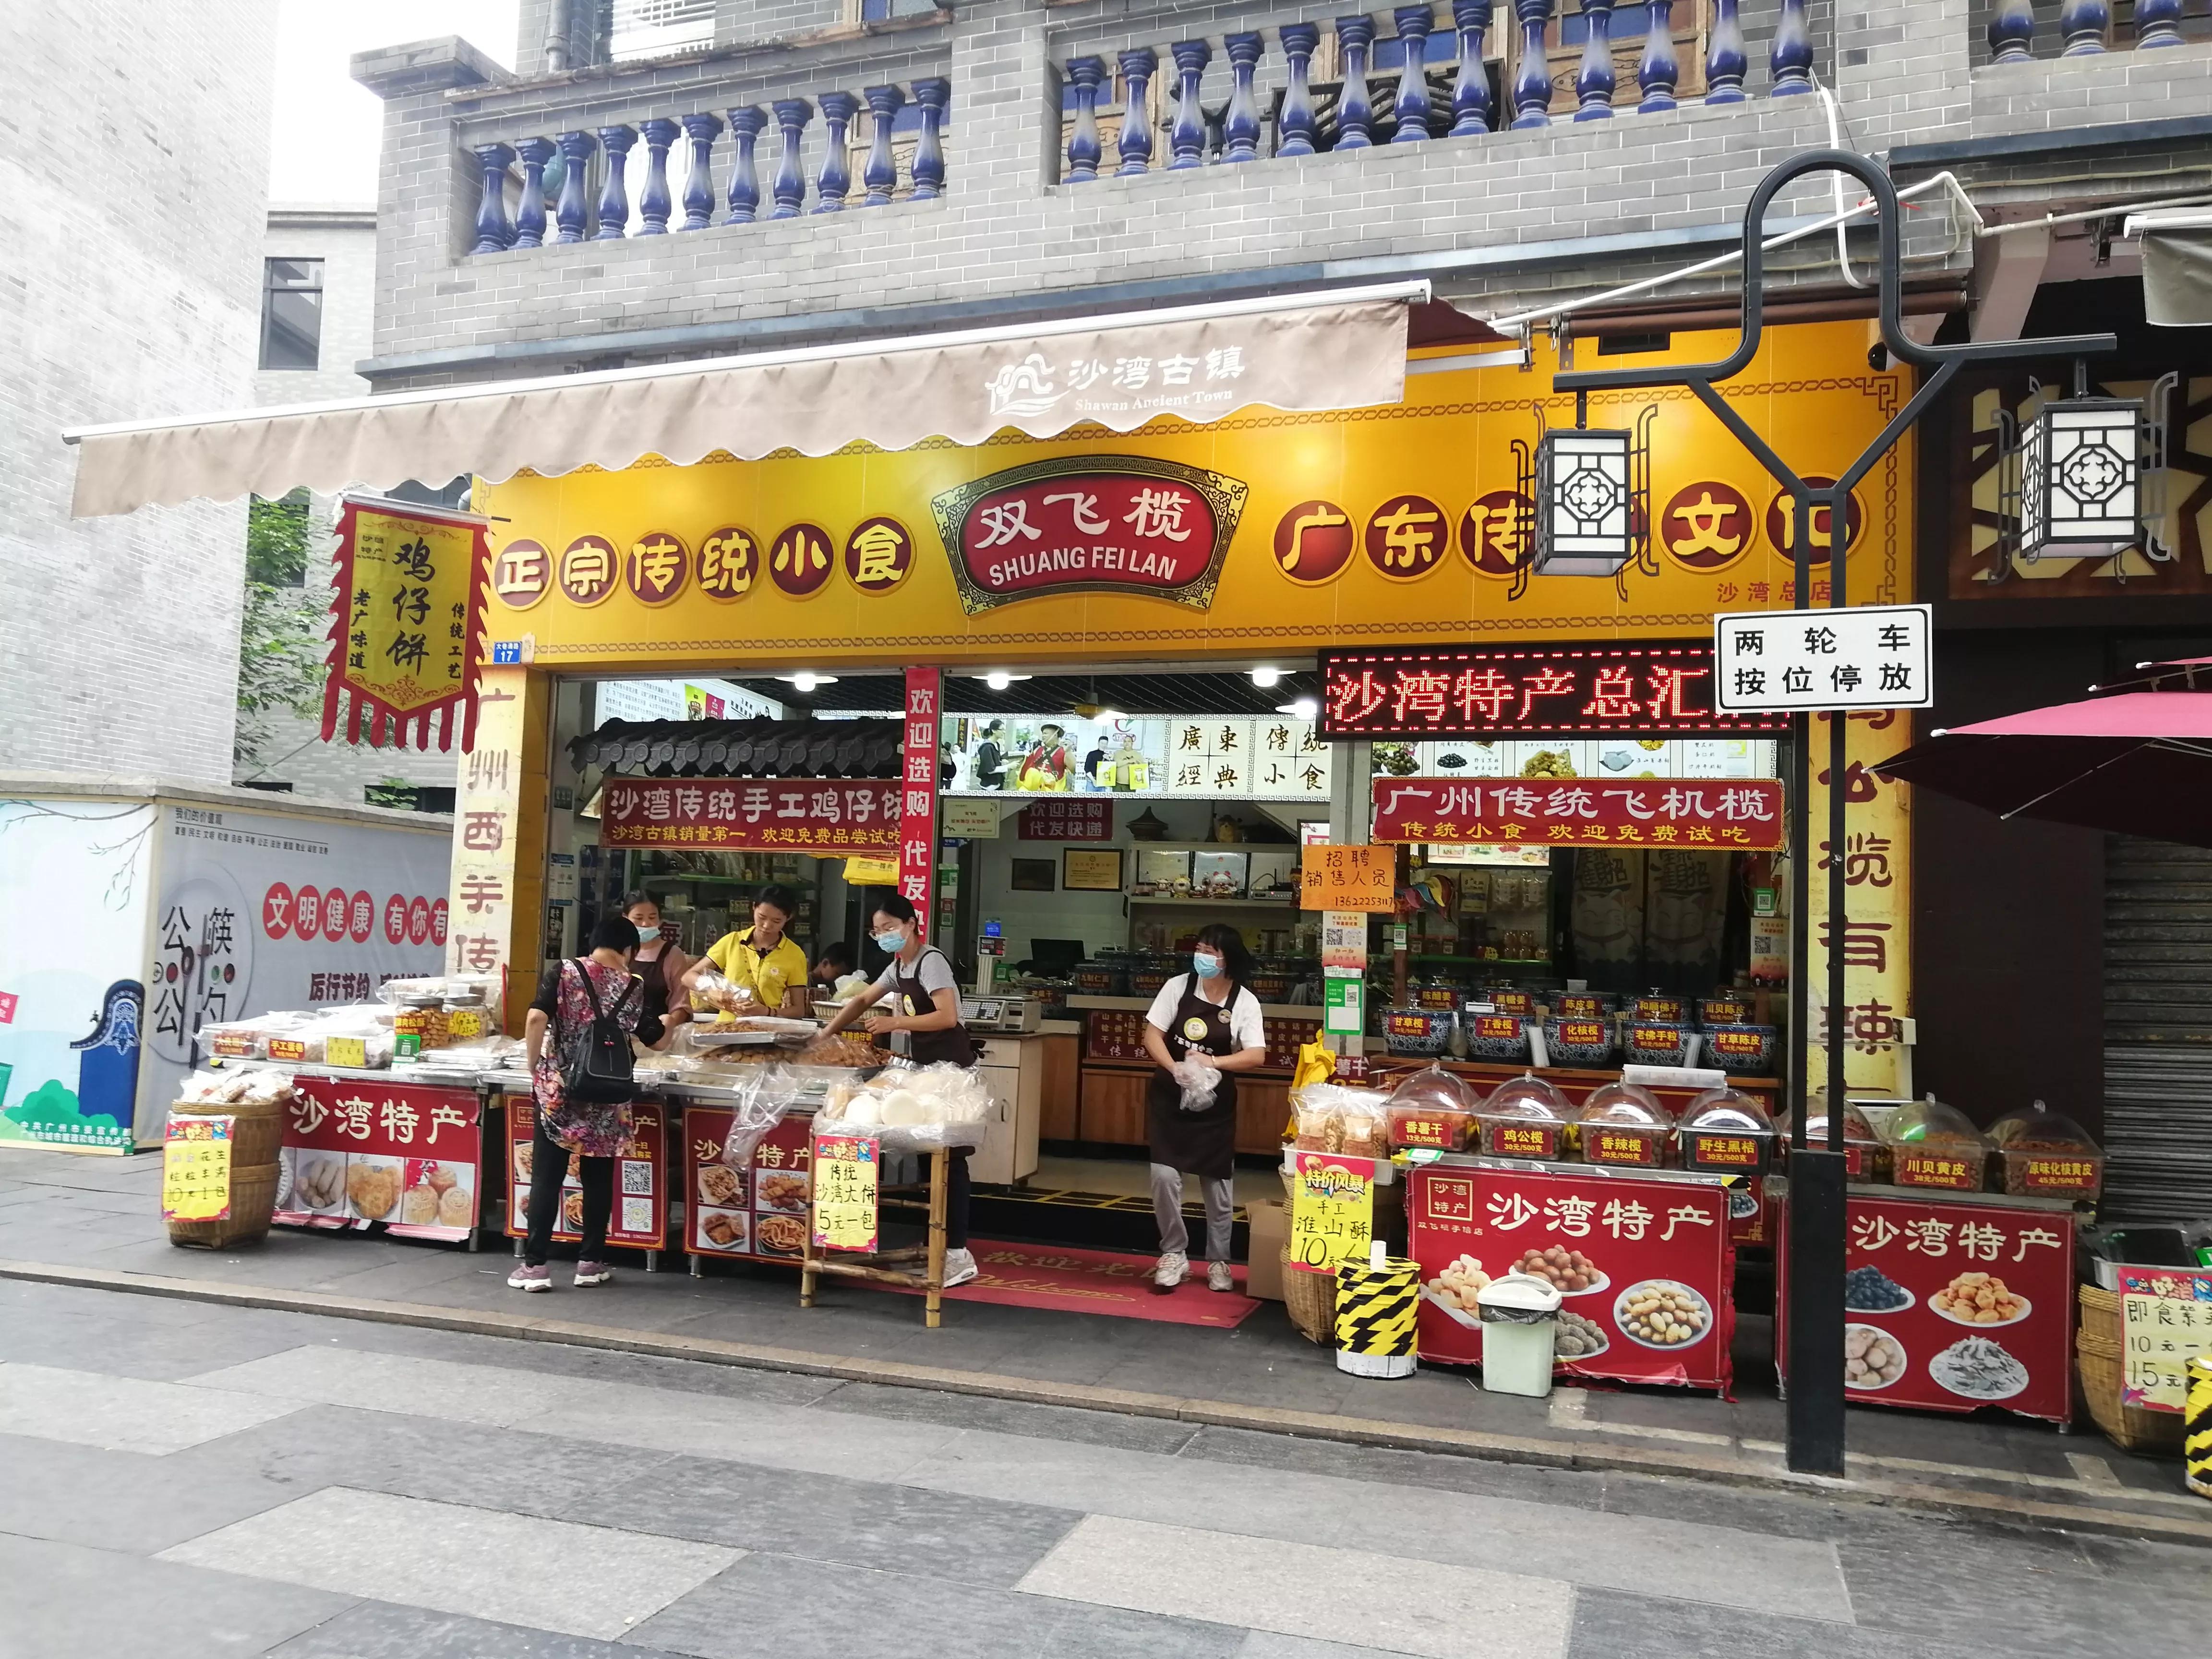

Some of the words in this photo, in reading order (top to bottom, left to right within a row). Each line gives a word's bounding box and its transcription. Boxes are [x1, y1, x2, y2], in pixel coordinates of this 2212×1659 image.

[1067, 344, 1246, 391] 沙湾古镇
[1075, 397, 1129, 412] Shawan
[1132, 392, 1190, 410] Ancient
[1193, 389, 1233, 404] Town
[974, 488, 1192, 550] 双飞榄
[1283, 492, 1852, 571] 广东传文化
[497, 526, 904, 596] 正宗传统小食
[989, 547, 1086, 587] SHUANG
[1091, 546, 1125, 570] FEI
[1129, 549, 1178, 581] LAN
[1717, 579, 1831, 603] 沙湾总店
[385, 536, 436, 676] 鸡仔饼
[349, 588, 371, 670] 老广味道
[447, 601, 466, 679] 传统工艺
[1734, 624, 1911, 657] 两轮车
[501, 650, 513, 662] 17
[1734, 662, 1912, 696] 按位停放
[1332, 664, 1710, 727] 沙湾特产总汇
[1178, 725, 1239, 752] 廣東
[1265, 723, 1328, 753] 傳統
[906, 688, 934, 818] 欢迎选购
[1175, 763, 1238, 789] 經典
[1264, 763, 1324, 790] 小食
[611, 786, 902, 824] 沙湾传统手工鸡仔饼
[1031, 801, 1103, 818] 欢迎选购
[1382, 786, 1774, 821] 广州传统飞机榄
[612, 825, 746, 843] 沙湾古镇销量第一
[761, 827, 901, 845] 欢迎免费品尝试吃
[1030, 820, 1102, 837] 代发快递
[1401, 822, 1527, 840] 传统小食
[1547, 824, 1751, 843] 欢迎免费试吃
[1326, 849, 1370, 868] 招聘
[1306, 869, 1390, 887] 销售人员
[267, 892, 370, 934] 文明健康
[1335, 896, 1393, 907] 13622253117
[162, 905, 234, 954] 公筷
[309, 973, 370, 1001] 厉行节约
[1395, 1016, 1424, 1028] 甘草榄
[1482, 1018, 1513, 1029] 丁香榄
[1717, 1033, 1760, 1046] 甘草陈皮
[289, 1094, 467, 1145] 沙湾特产
[1406, 1120, 1443, 1136] 番薯干
[1503, 1130, 1544, 1145] 鸡公榄
[1503, 1143, 1543, 1153] 30元/500克
[1601, 1136, 1643, 1153] 香辣榄
[693, 1139, 810, 1168] 沙特产
[1600, 1151, 1641, 1161] 30元/500克
[1706, 1153, 1747, 1163] 30元/500克
[830, 1164, 858, 1181] 传统
[1906, 1159, 1966, 1177] 川贝黄皮
[2029, 1161, 2093, 1177] 原味化核黄皮
[815, 1184, 877, 1204] 沙湾大饼
[1305, 1169, 1366, 1198] 特价风暴
[1317, 1199, 1345, 1215] 手工
[1434, 1201, 1467, 1214] 特产
[1486, 1192, 1715, 1241] 沙湾特产
[819, 1210, 876, 1230] 5元一包
[1296, 1216, 1370, 1241] 淮山酥
[1851, 1215, 2062, 1263] 沙湾特产
